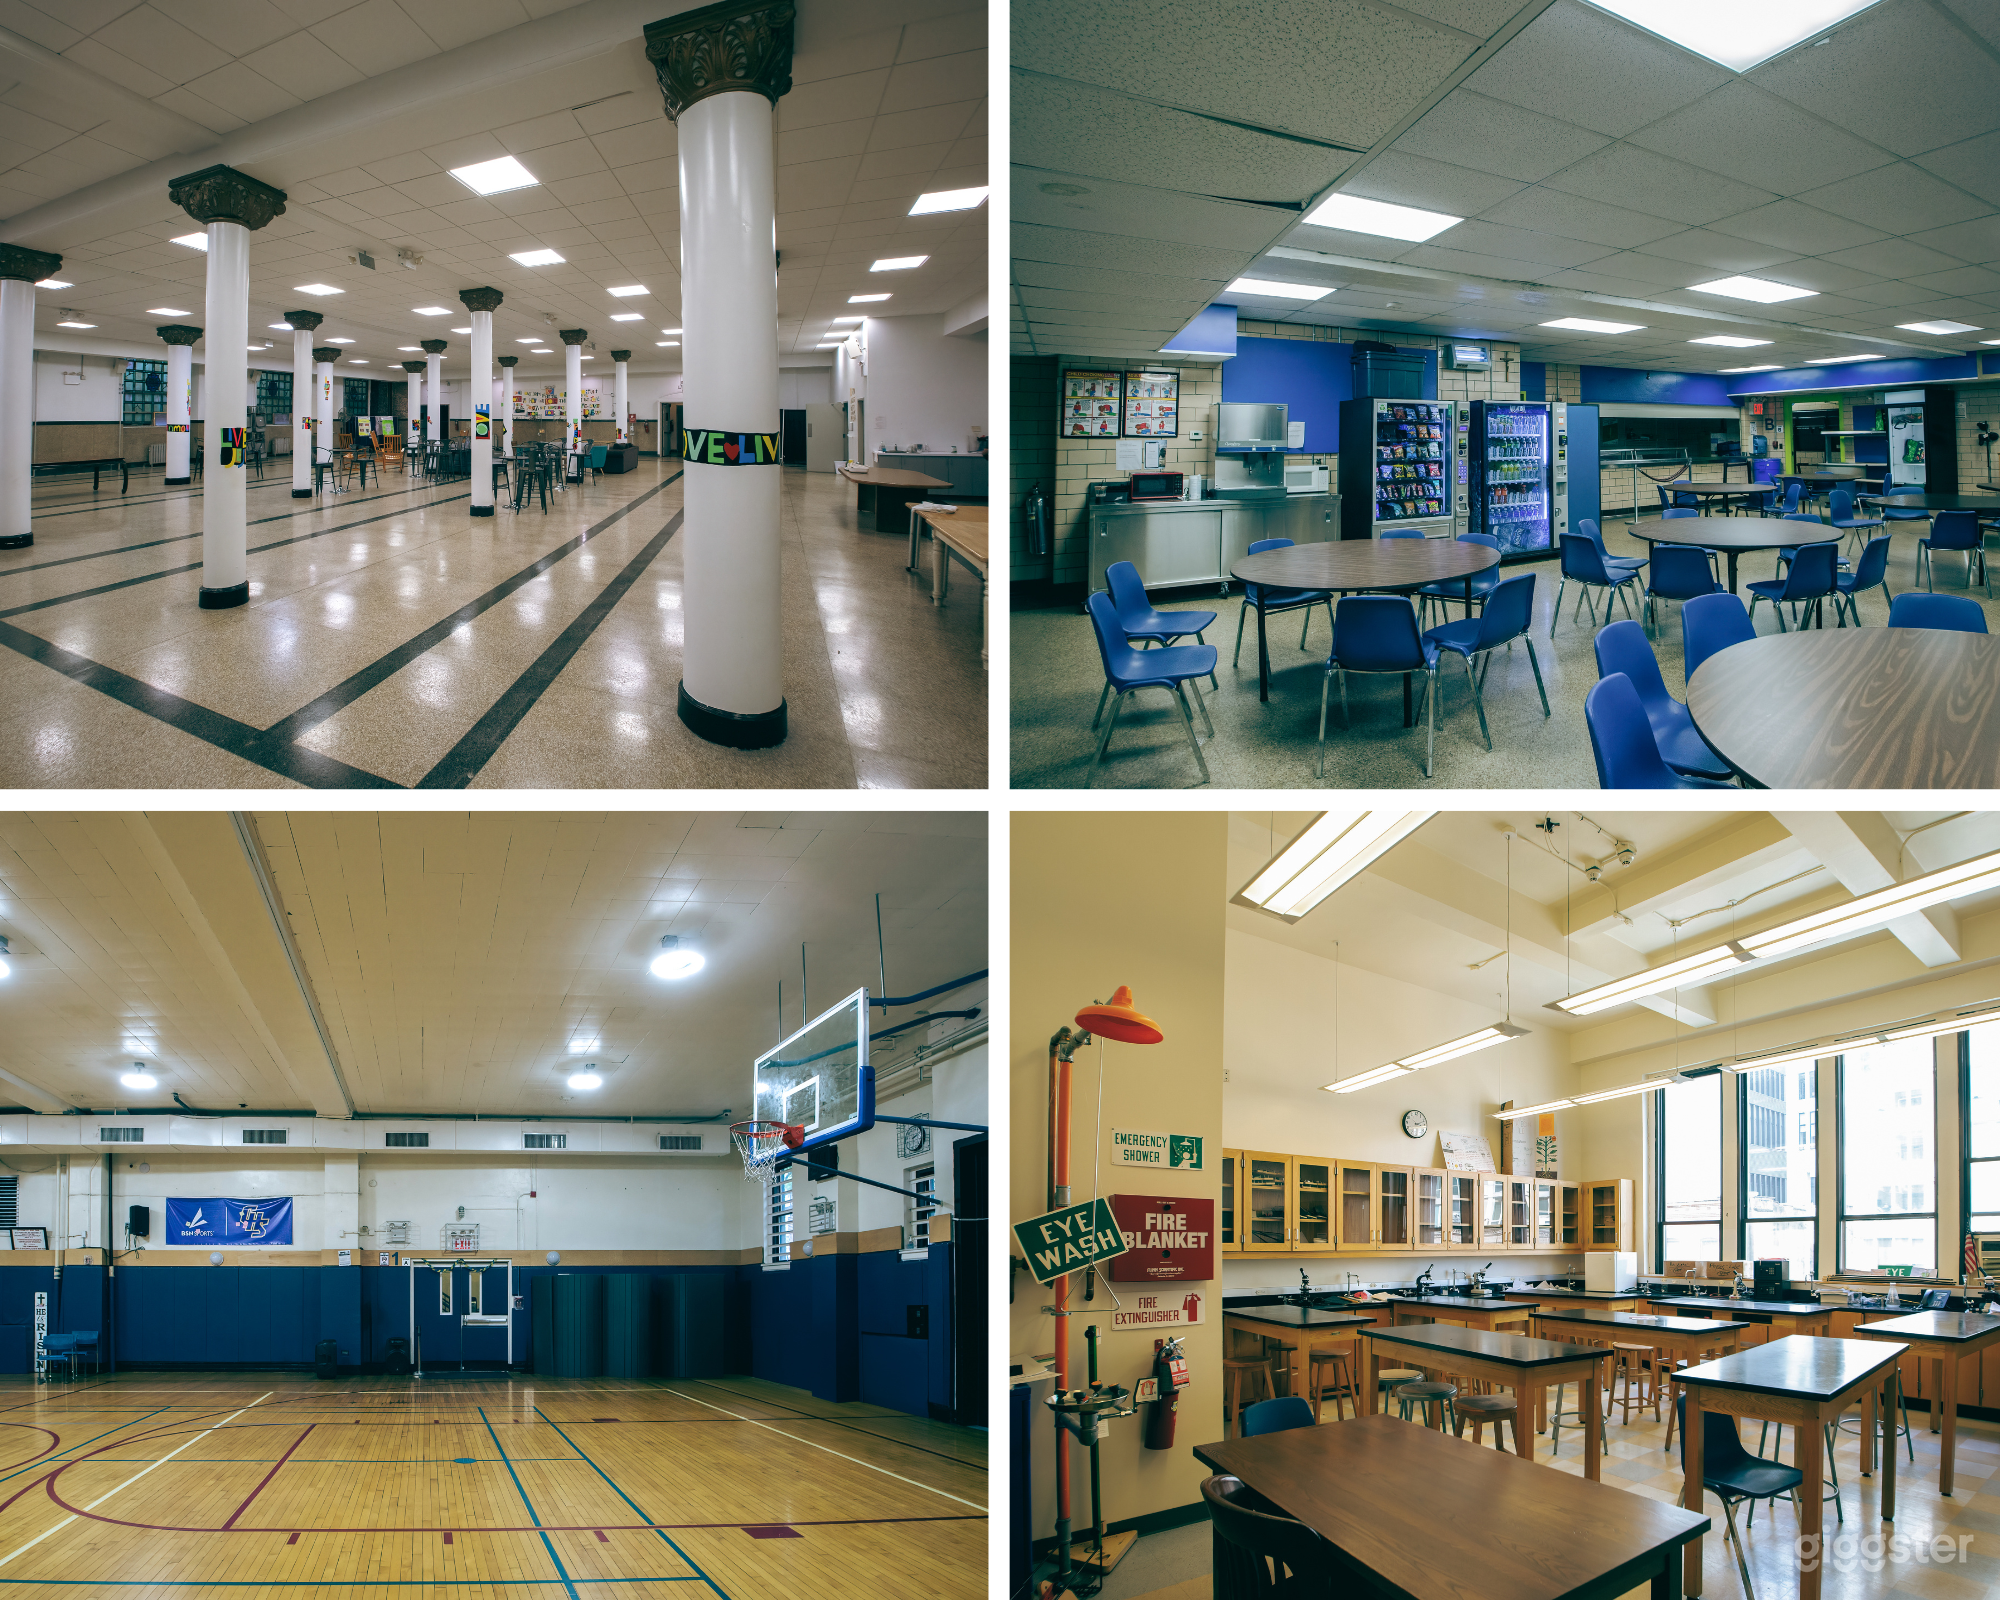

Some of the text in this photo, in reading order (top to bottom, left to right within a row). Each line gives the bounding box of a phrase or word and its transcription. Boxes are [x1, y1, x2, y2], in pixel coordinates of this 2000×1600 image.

[1754, 404, 1763, 414] EXIT
[1765, 418, 1774, 430] B
[1115, 1133, 1167, 1148] EMERGENCY
[1124, 1149, 1160, 1162] SHOWER
[1039, 1211, 1093, 1244] EYE
[1145, 1213, 1187, 1230] FIRE
[1122, 1232, 1208, 1249] BLANKET
[1035, 1228, 1117, 1270] WASH
[392, 1252, 398, 1265] 1
[1886, 1268, 1905, 1276] EYE
[1139, 1297, 1158, 1308] FIRE
[1115, 1310, 1179, 1325] EXTINGUISHER
